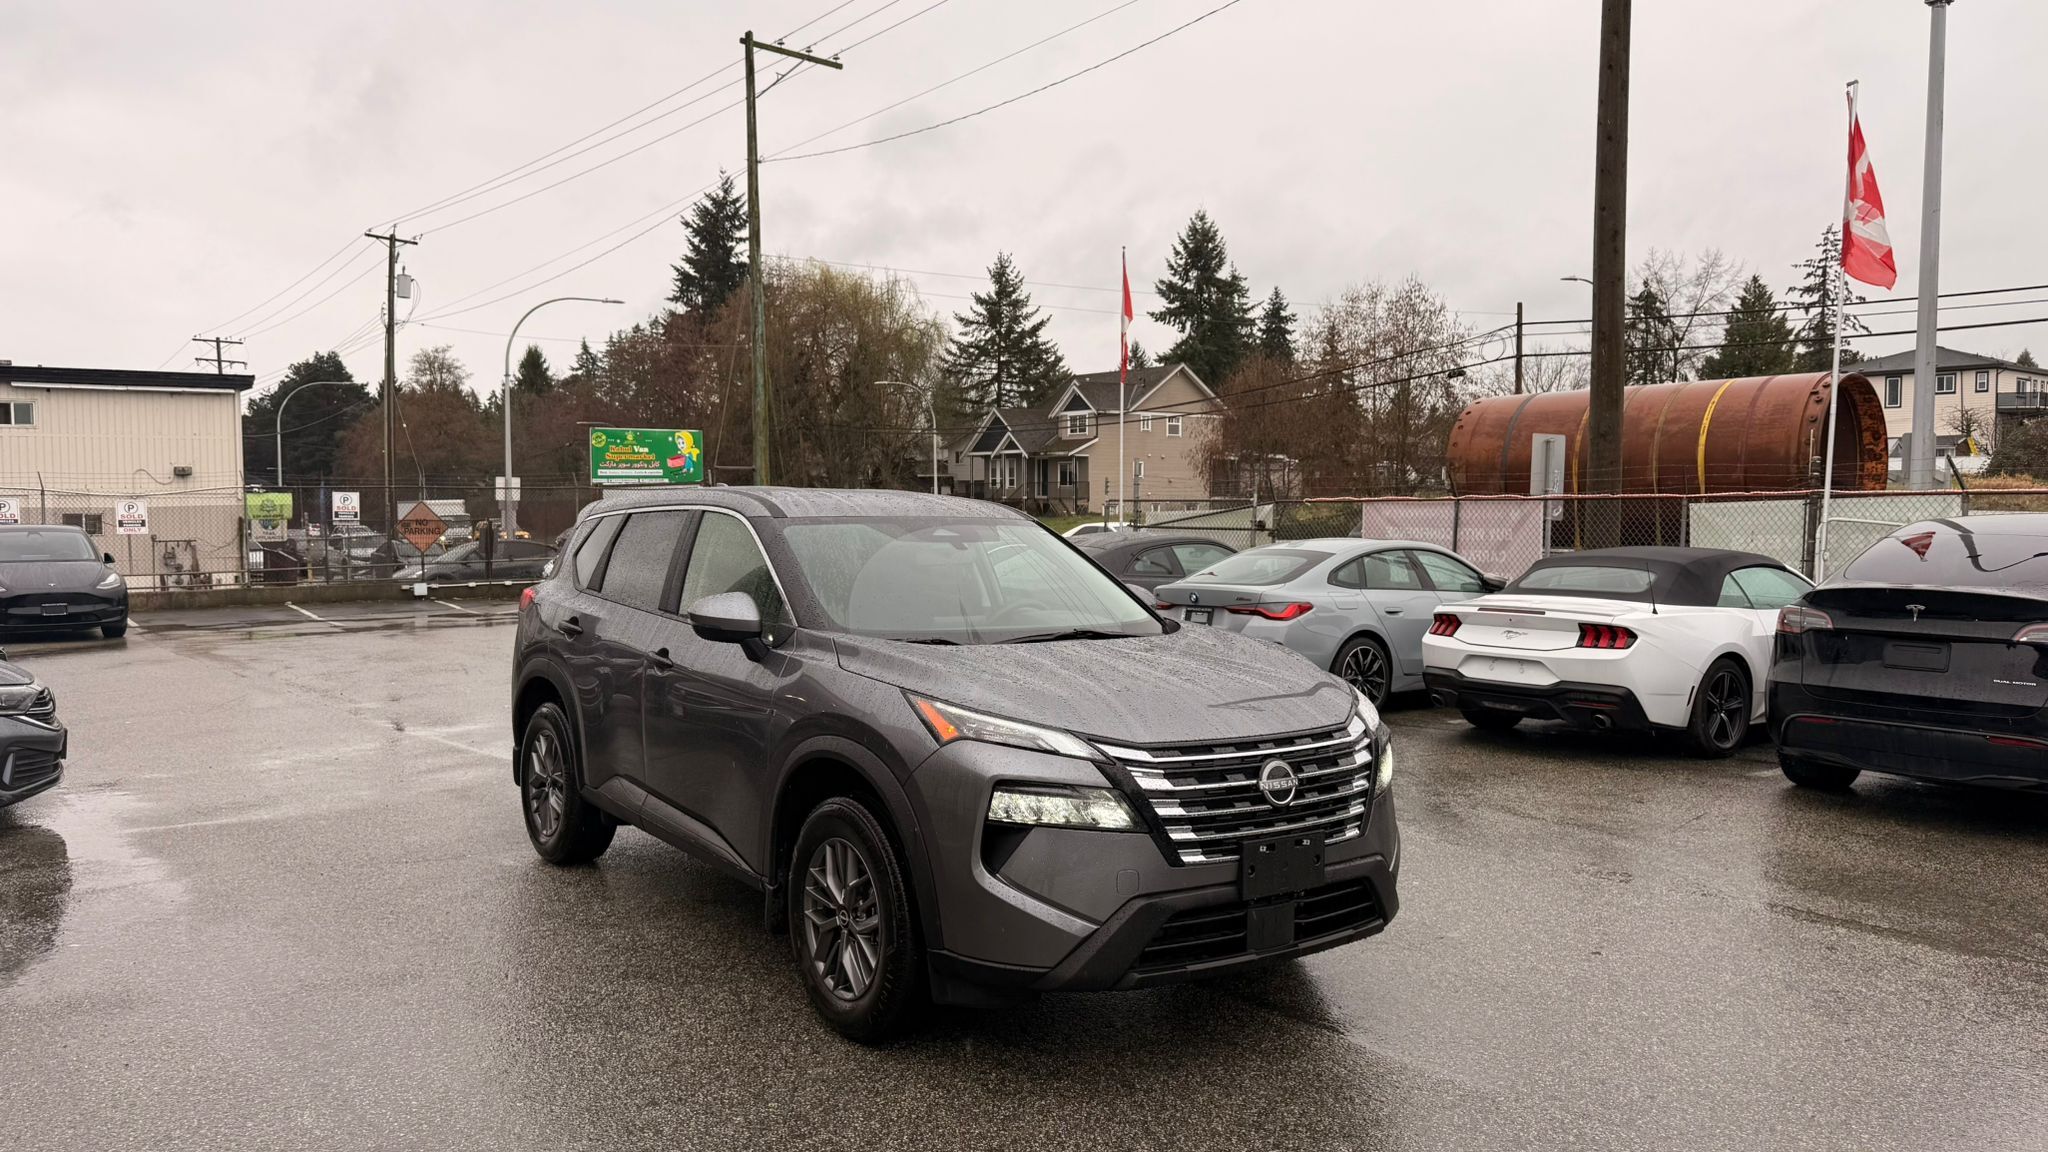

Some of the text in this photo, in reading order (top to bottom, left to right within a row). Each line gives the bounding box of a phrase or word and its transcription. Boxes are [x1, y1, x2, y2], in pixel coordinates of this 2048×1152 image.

[633, 445, 649, 453] Van
[605, 452, 656, 461] Supermarket
[415, 519, 429, 527] NO
[404, 527, 441, 535] PARKING
[1259, 777, 1298, 791] NISSAN
